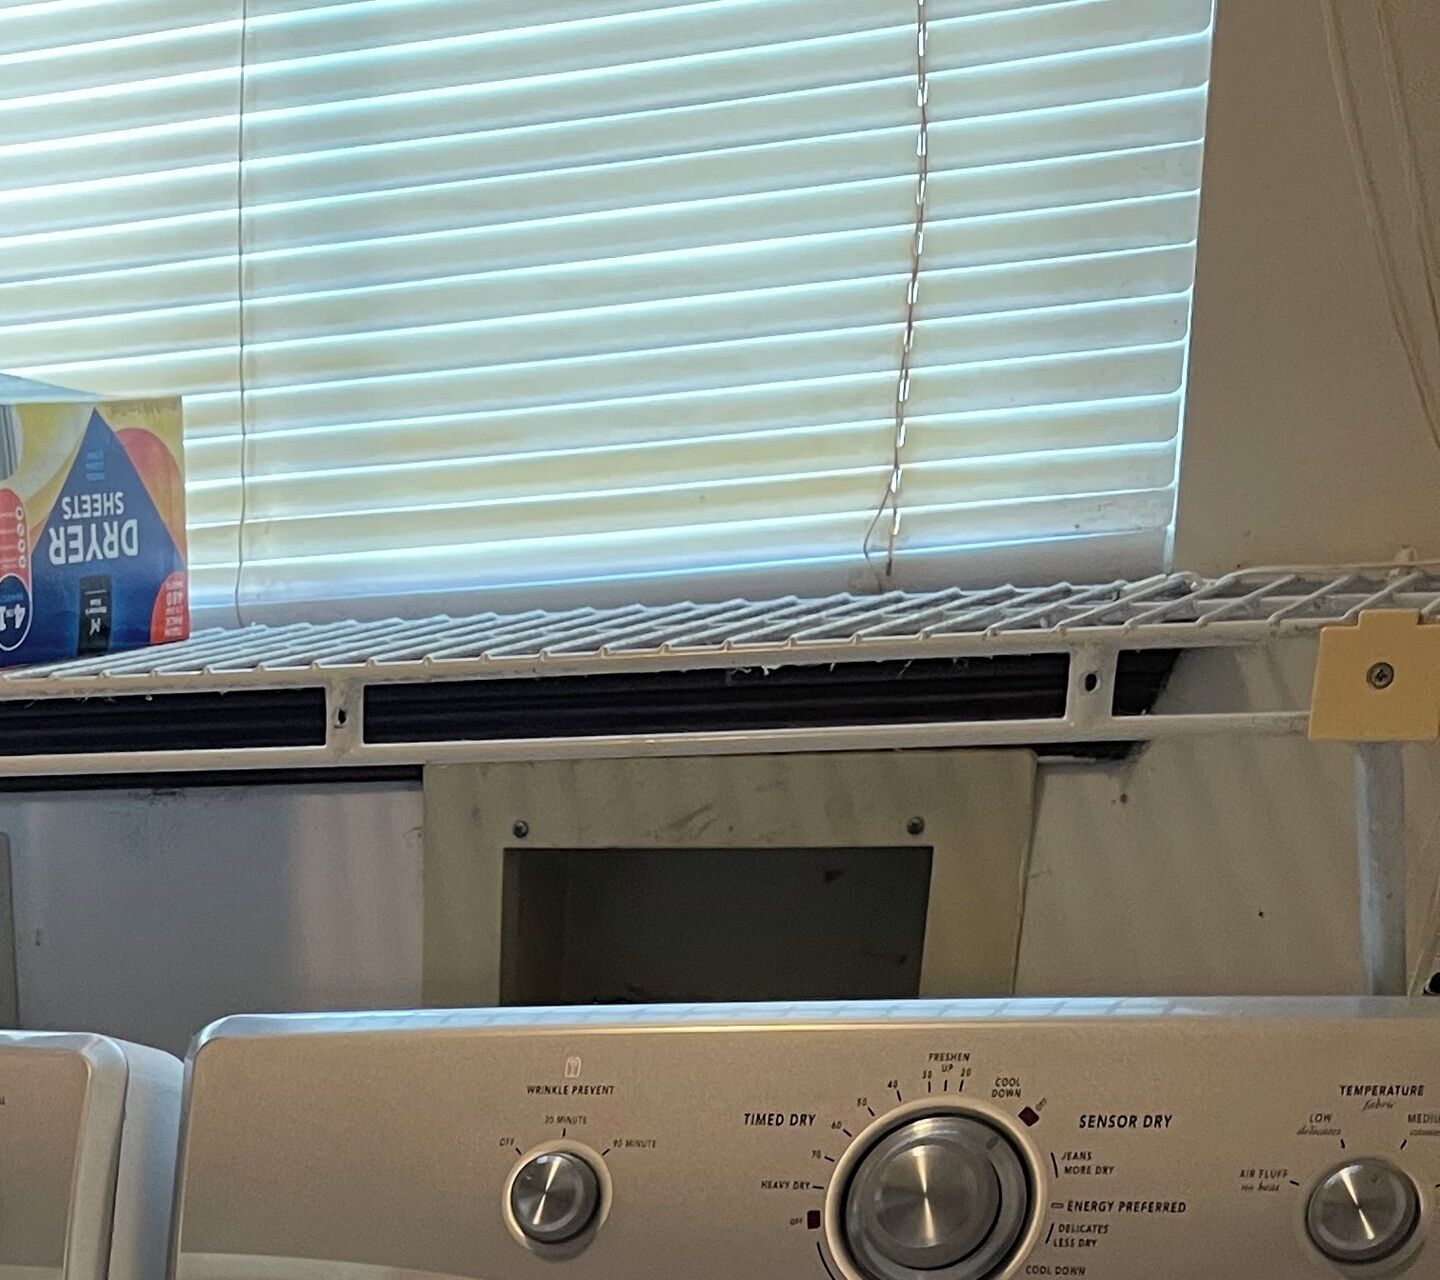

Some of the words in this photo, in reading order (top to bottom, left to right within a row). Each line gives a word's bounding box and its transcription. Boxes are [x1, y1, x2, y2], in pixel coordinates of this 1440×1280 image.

[61, 491, 124, 520] SHEETS
[48, 519, 139, 566] DRYER
[928, 1053, 971, 1062] FRESHEN
[941, 1064, 954, 1073] UP
[887, 1080, 898, 1089] 40
[995, 1077, 1021, 1087] COOL
[526, 1085, 569, 1096] WRINKLE
[571, 1085, 615, 1096] PREVENT
[991, 1089, 1022, 1098] DOWN
[1339, 1084, 1425, 1097] TEMPERATURE
[557, 1115, 588, 1125] MINUTE
[744, 1113, 785, 1126] TIMED
[789, 1113, 816, 1126] DRY
[1079, 1114, 1138, 1129] SENSOR
[1143, 1114, 1173, 1129] DRY
[1309, 1113, 1333, 1123] LOW
[1061, 1151, 1093, 1160] JEANS
[1064, 1166, 1092, 1175] MORE
[1095, 1166, 1115, 1175] DRY
[1258, 1169, 1289, 1179] FLUFF
[761, 1180, 790, 1189] HEAVY
[792, 1180, 811, 1189] DRY
[1067, 1200, 1114, 1212] ENERGY
[1118, 1201, 1187, 1213] PREFERRED
[1058, 1224, 1109, 1234] DELICATES
[1053, 1238, 1075, 1248] LESS
[1078, 1238, 1098, 1247] DRY
[1026, 1265, 1052, 1275] COOL
[1055, 1265, 1086, 1276] DOWN
